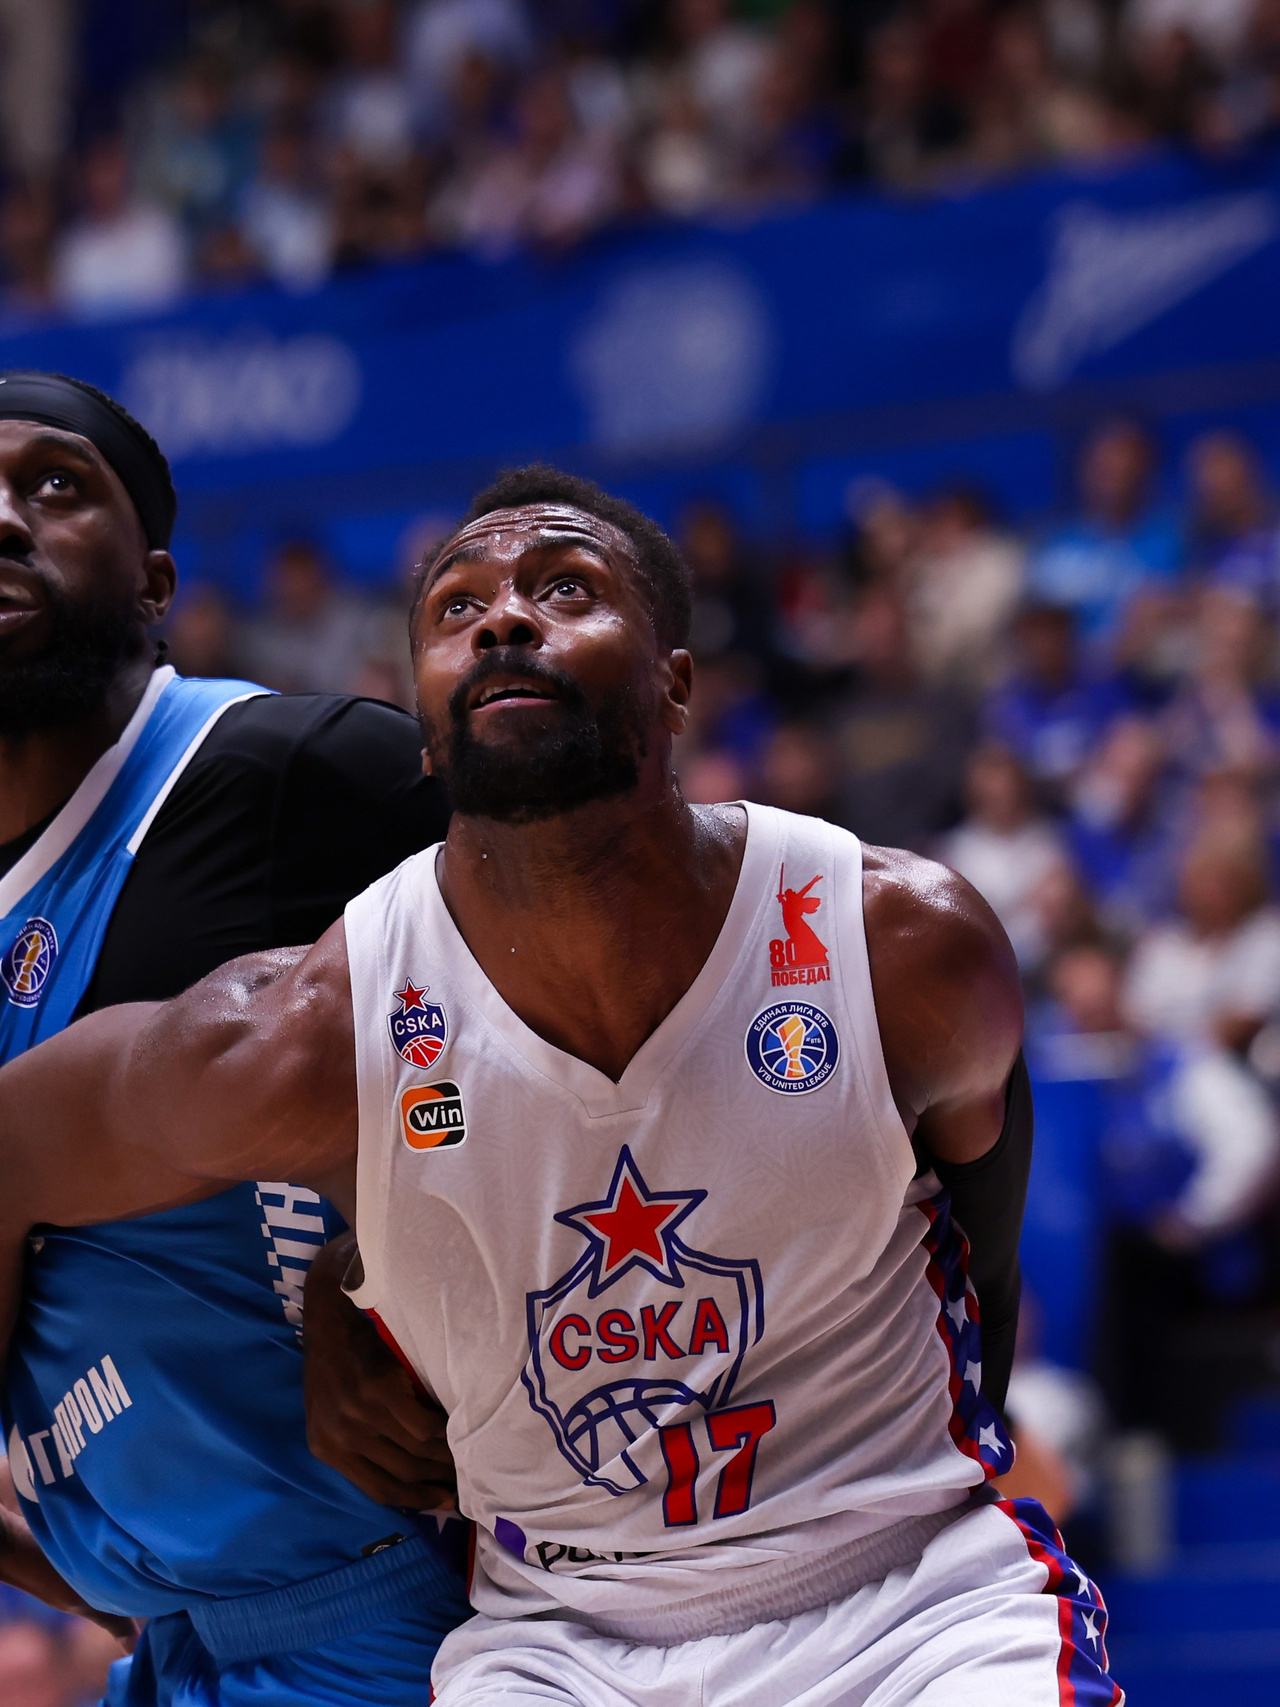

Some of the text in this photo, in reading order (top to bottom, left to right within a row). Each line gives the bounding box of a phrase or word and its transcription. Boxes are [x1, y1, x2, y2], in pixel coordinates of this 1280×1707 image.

[768, 939, 797, 968] 80
[771, 966, 831, 987] ПОБЕДА!
[394, 1012, 443, 1036] CSKA
[753, 1004, 829, 1032] ЕДИНАЯ ЛИГА ВТБ
[757, 1062, 832, 1090] VTB UNITED LEAGUE
[414, 1105, 462, 1128] Win
[549, 1297, 730, 1371] CSKA
[658, 1399, 777, 1528] 17
